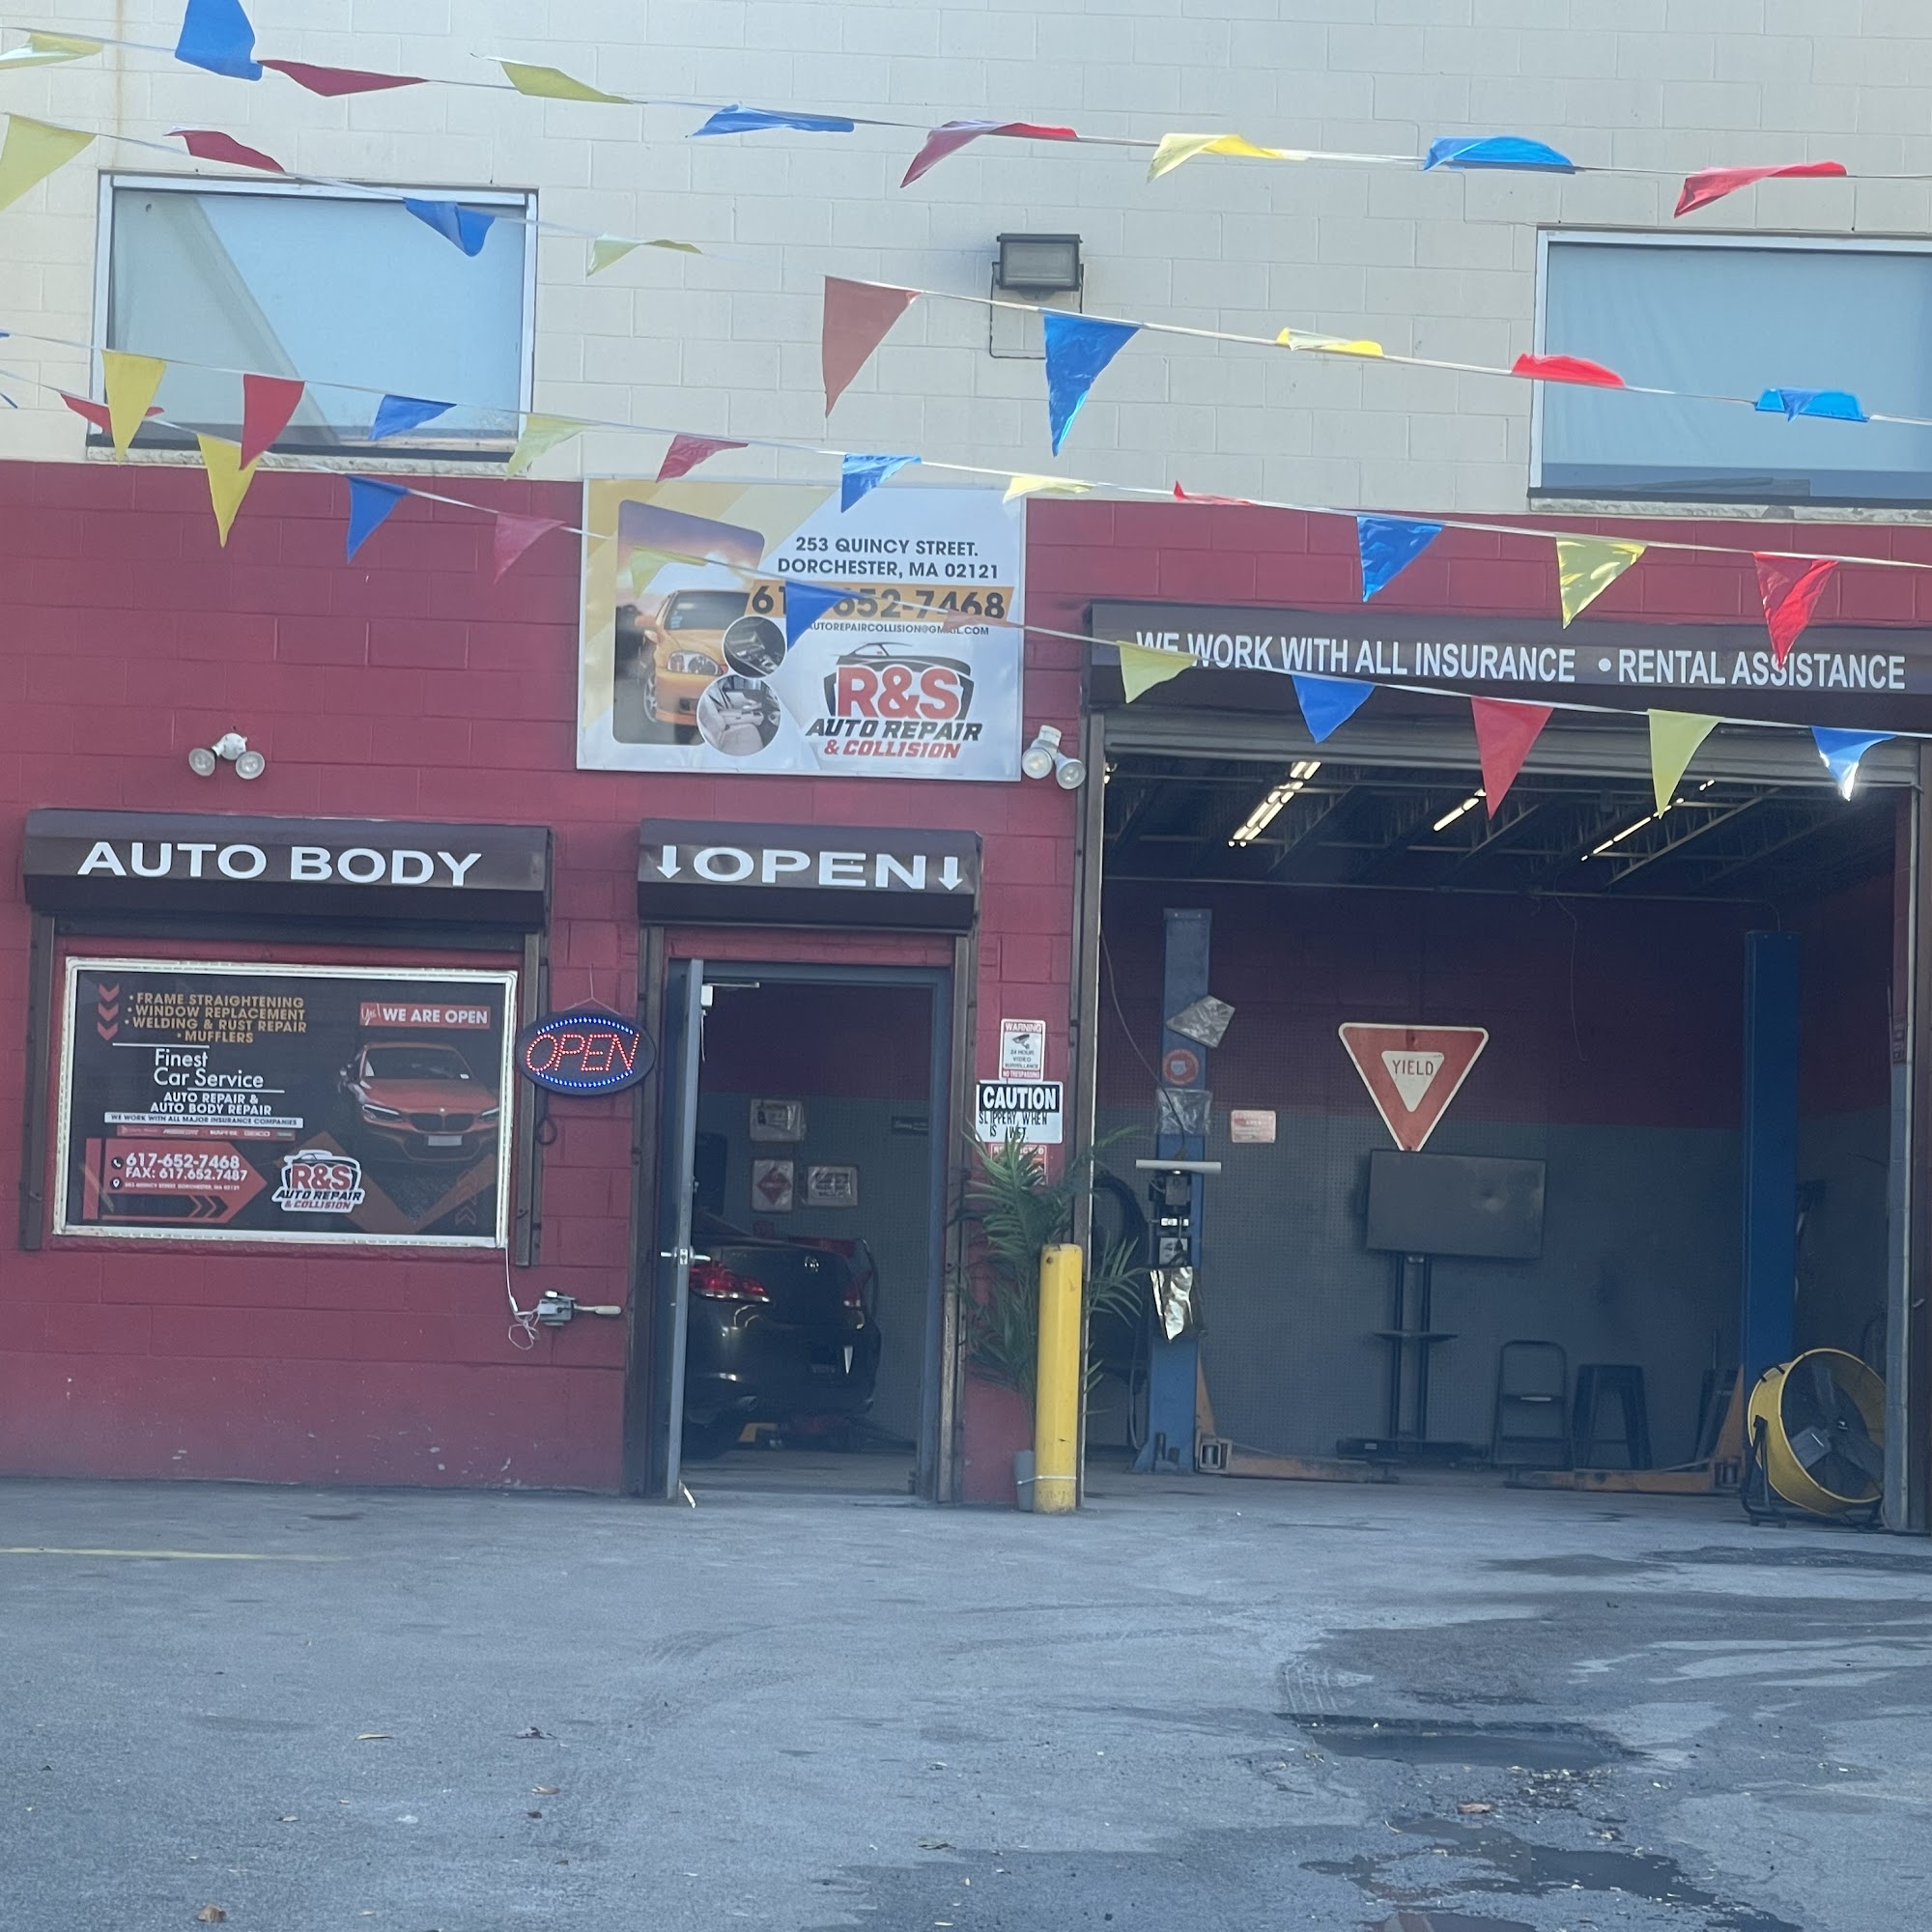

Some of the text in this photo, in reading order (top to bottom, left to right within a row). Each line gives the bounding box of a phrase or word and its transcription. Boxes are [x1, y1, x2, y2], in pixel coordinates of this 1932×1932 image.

[795, 536, 979, 557] 253 QUINCY STREET.
[778, 557, 998, 580] DORCHESTER, MA 02121
[1187, 633, 1274, 670] WORK
[1280, 637, 1350, 673] WITH
[1354, 639, 1408, 675] ALL
[1415, 641, 1576, 683] INSURANCE
[1618, 648, 1726, 685] RENTAL
[1731, 650, 1906, 690] ASSISTANCE
[838, 666, 960, 720] R&S
[806, 718, 983, 742] AUTO REPAIR
[824, 739, 962, 759] & COLLISION
[77, 840, 482, 887] AUTO BODY
[693, 846, 927, 891] OPEN
[136, 992, 305, 1009] FRAME STRAIGHTENING
[135, 1005, 305, 1021] WINDOW REPLACEMENT
[383, 1008, 407, 1022] WE
[411, 1009, 440, 1023] ARE
[444, 1009, 488, 1024] OPEN
[132, 1016, 307, 1034] WELDING & RUST REPAIR
[1005, 1022, 1042, 1033] WARNING
[185, 1031, 254, 1043] MUFFLERS
[155, 1048, 208, 1067] Finest
[526, 1033, 639, 1072] OPEN
[1392, 1059, 1434, 1076] YIELD
[154, 1066, 264, 1088] Car Service
[163, 1092, 259, 1104] AUTO REPAIR &
[982, 1086, 1057, 1111] CAUTION
[150, 1102, 272, 1116] AUTO BODY REPAIR
[979, 1110, 1048, 1125] SLIPPERY WHEN
[989, 1124, 998, 1138] IS
[126, 1152, 241, 1170] 617-652-7468
[126, 1167, 248, 1181] FAX: 617.652.7487
[292, 1164, 351, 1190] R&S
[275, 1189, 362, 1201] AUTO REPAIR
[293, 1200, 352, 1209] COLLISION
